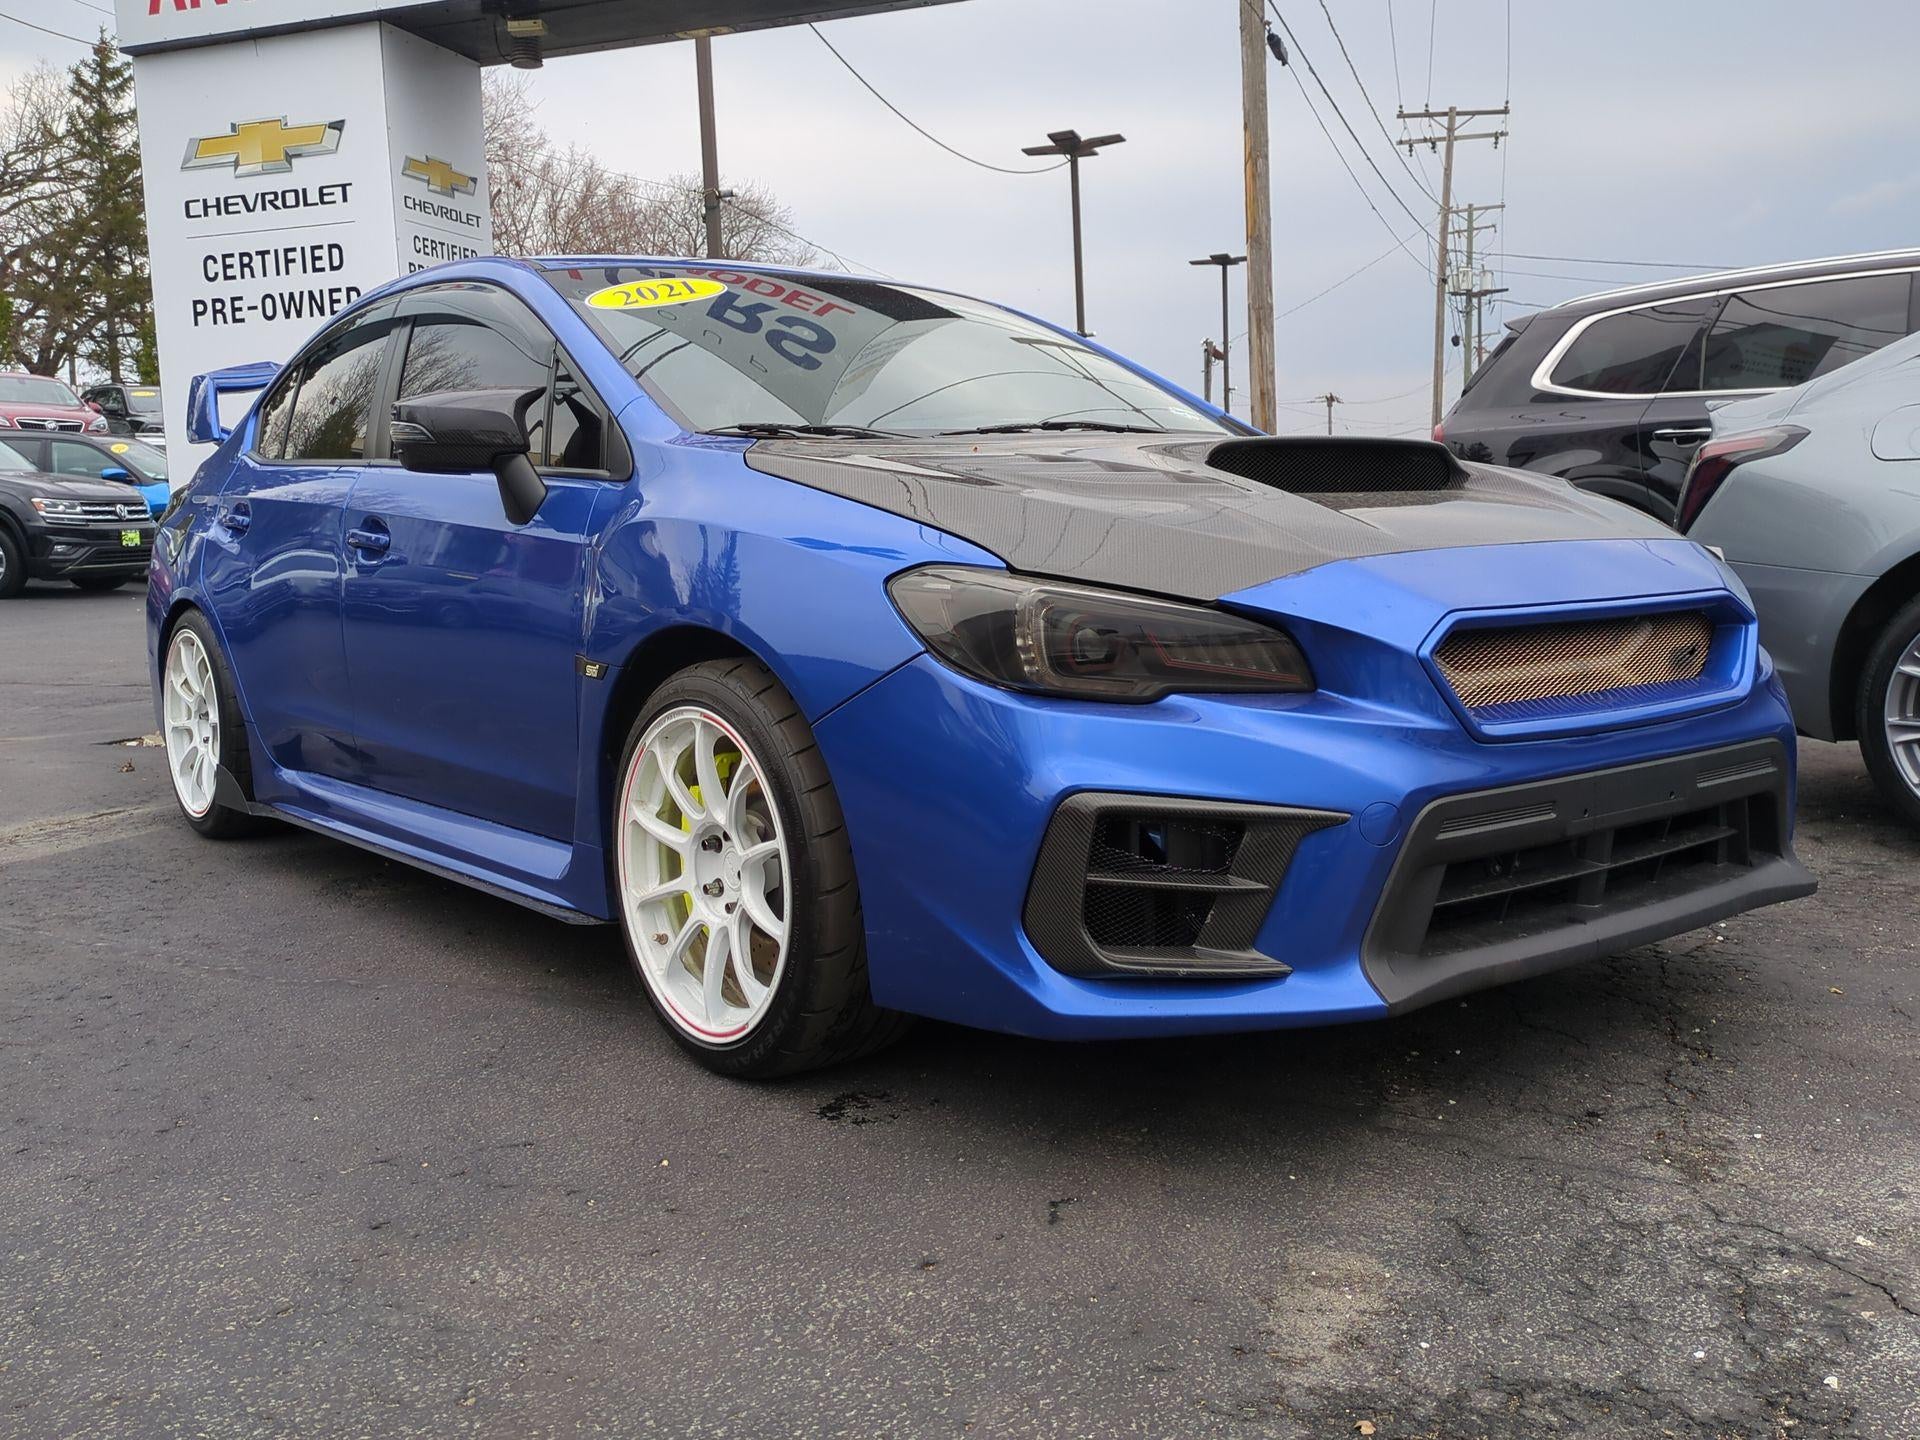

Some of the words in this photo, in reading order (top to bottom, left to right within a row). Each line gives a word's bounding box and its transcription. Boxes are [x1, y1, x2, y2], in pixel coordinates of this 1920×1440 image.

[184, 182, 353, 219] CHEVROLET
[403, 195, 482, 228] CHEVROLET
[202, 242, 345, 283] CERTIFIED
[612, 280, 696, 306] 2021
